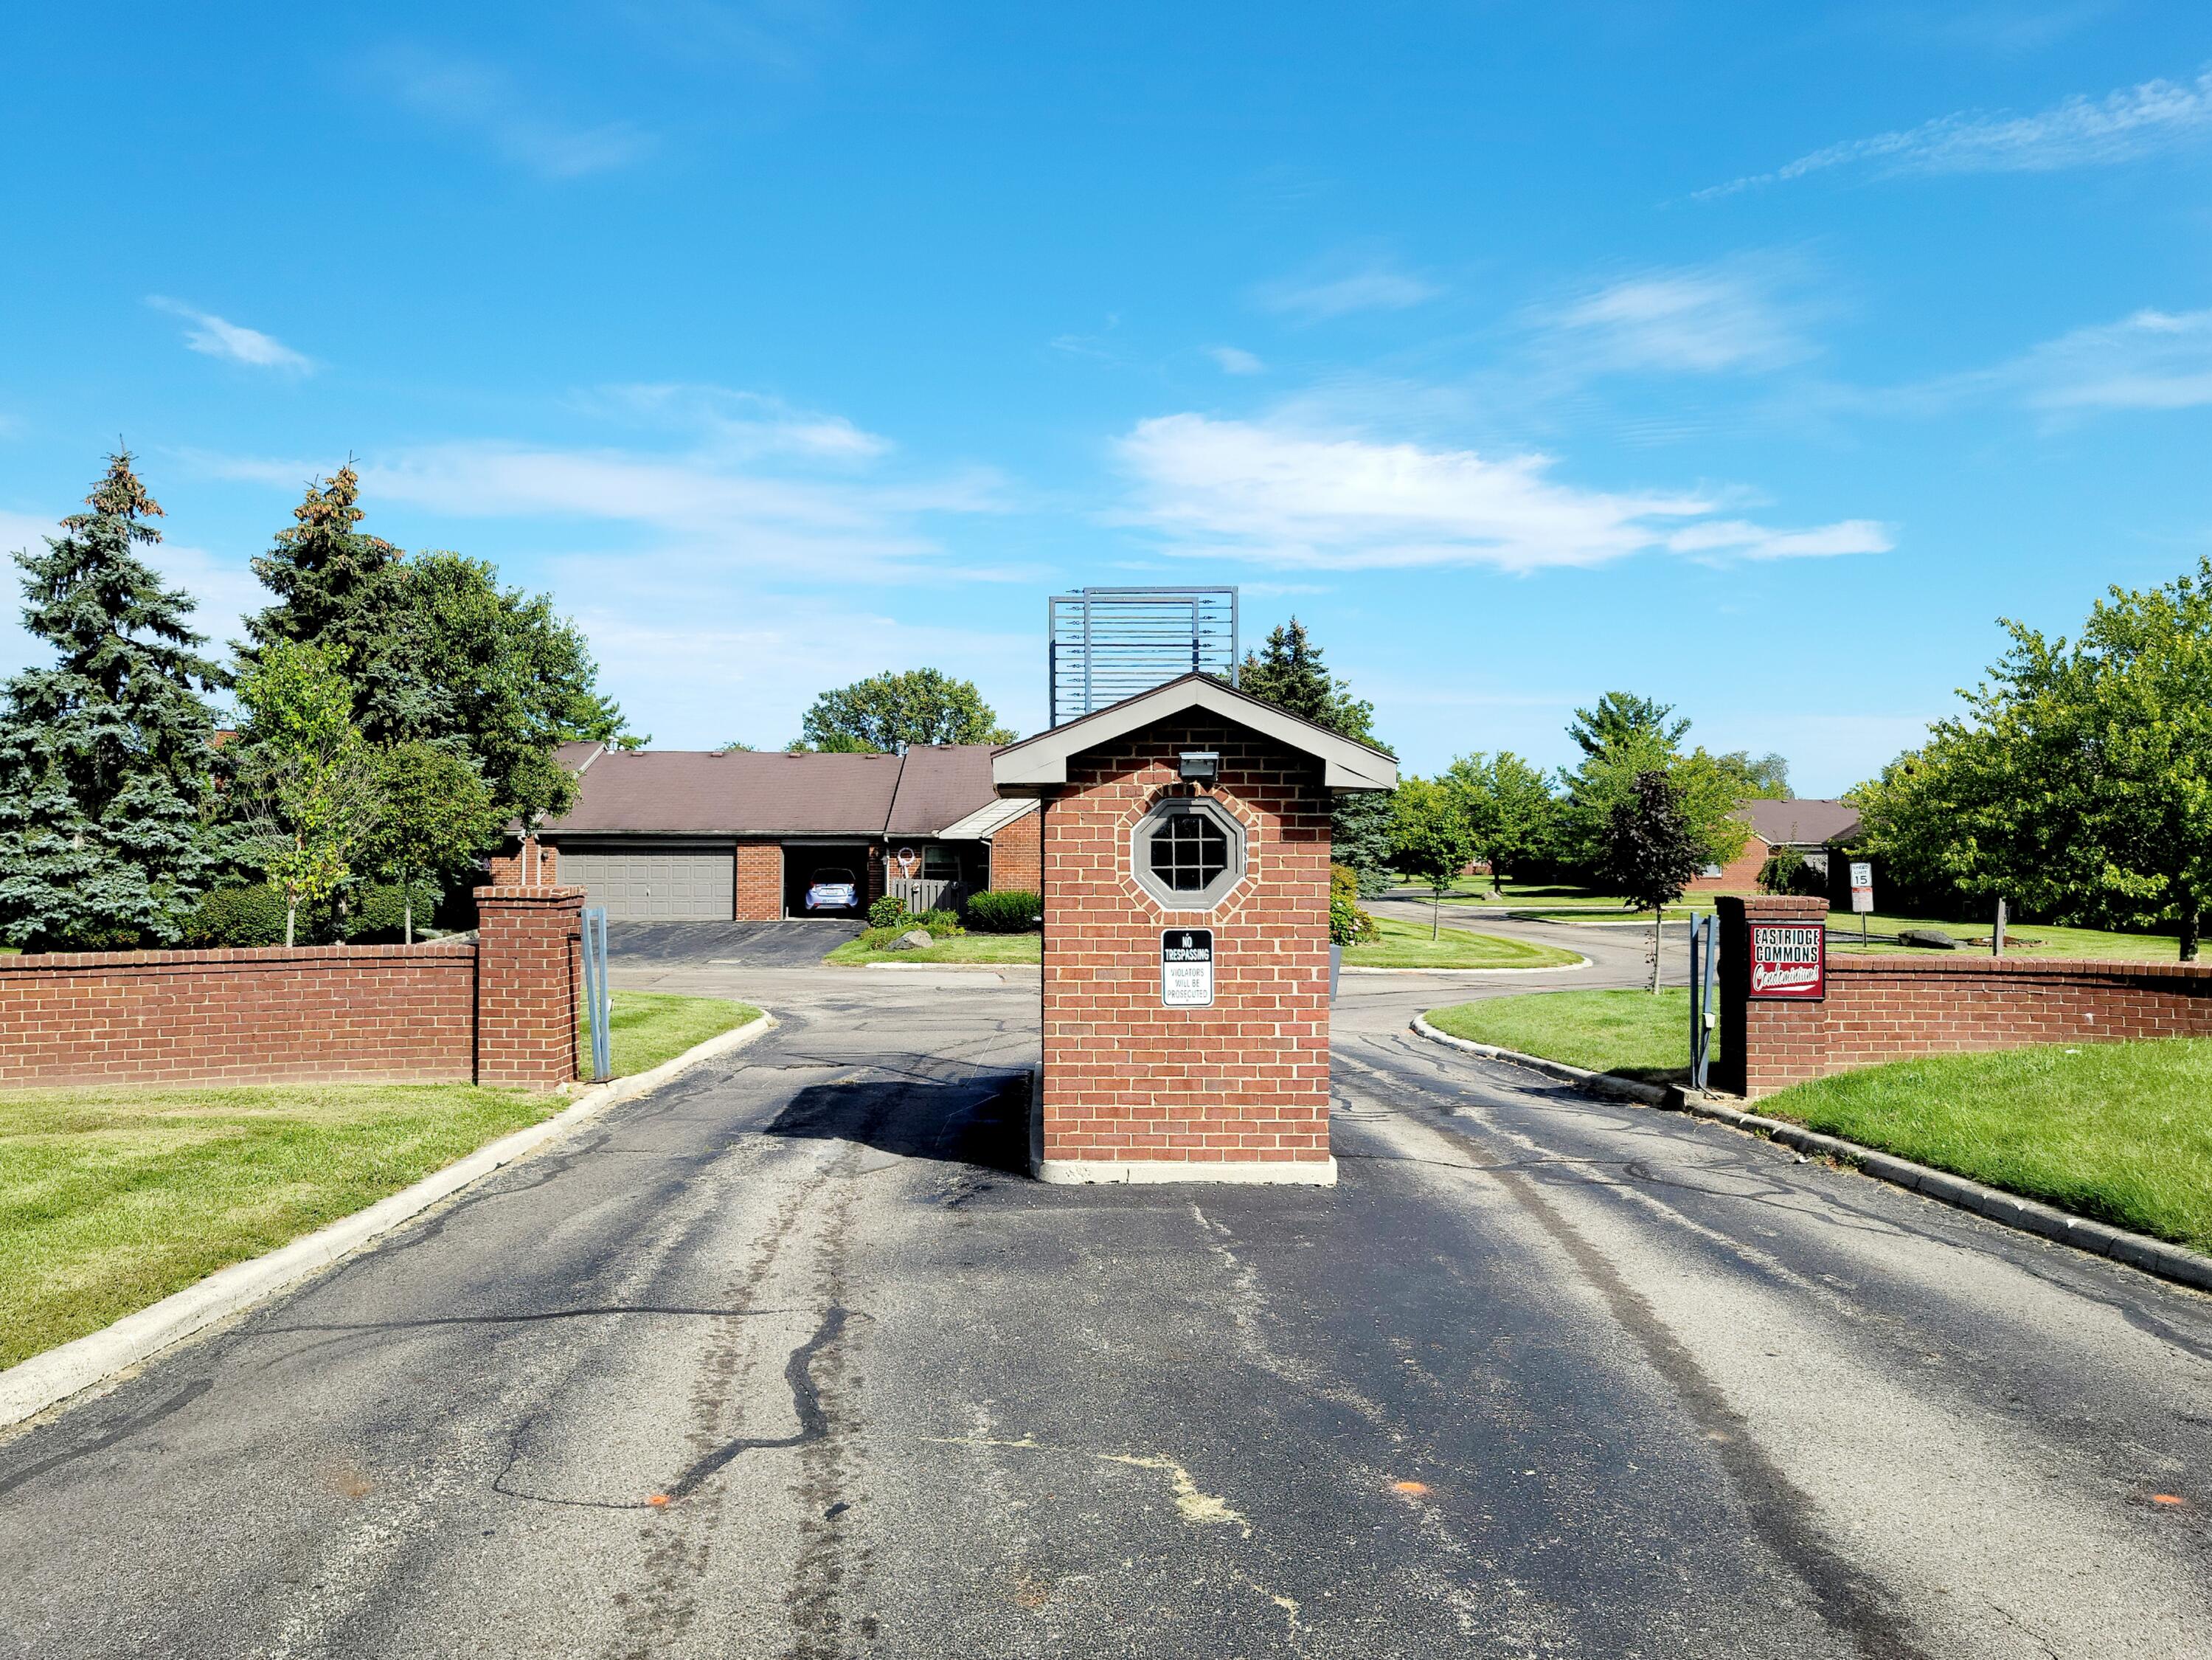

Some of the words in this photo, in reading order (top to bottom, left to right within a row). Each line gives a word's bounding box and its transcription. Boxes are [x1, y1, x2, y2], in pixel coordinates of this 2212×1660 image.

[1855, 876, 1868, 885] 15
[1182, 936, 1193, 948] NO
[1755, 928, 1820, 945] EASTRIDGE
[1165, 948, 1210, 961] TRESPASSING
[1755, 946, 1818, 962] COMMONS
[1171, 968, 1204, 977] VIOLATORS
[1753, 964, 1819, 991] Condominiums
[1175, 979, 1190, 987] WILL
[1192, 979, 1200, 987] BE
[1167, 989, 1208, 998] PROSECUTED
